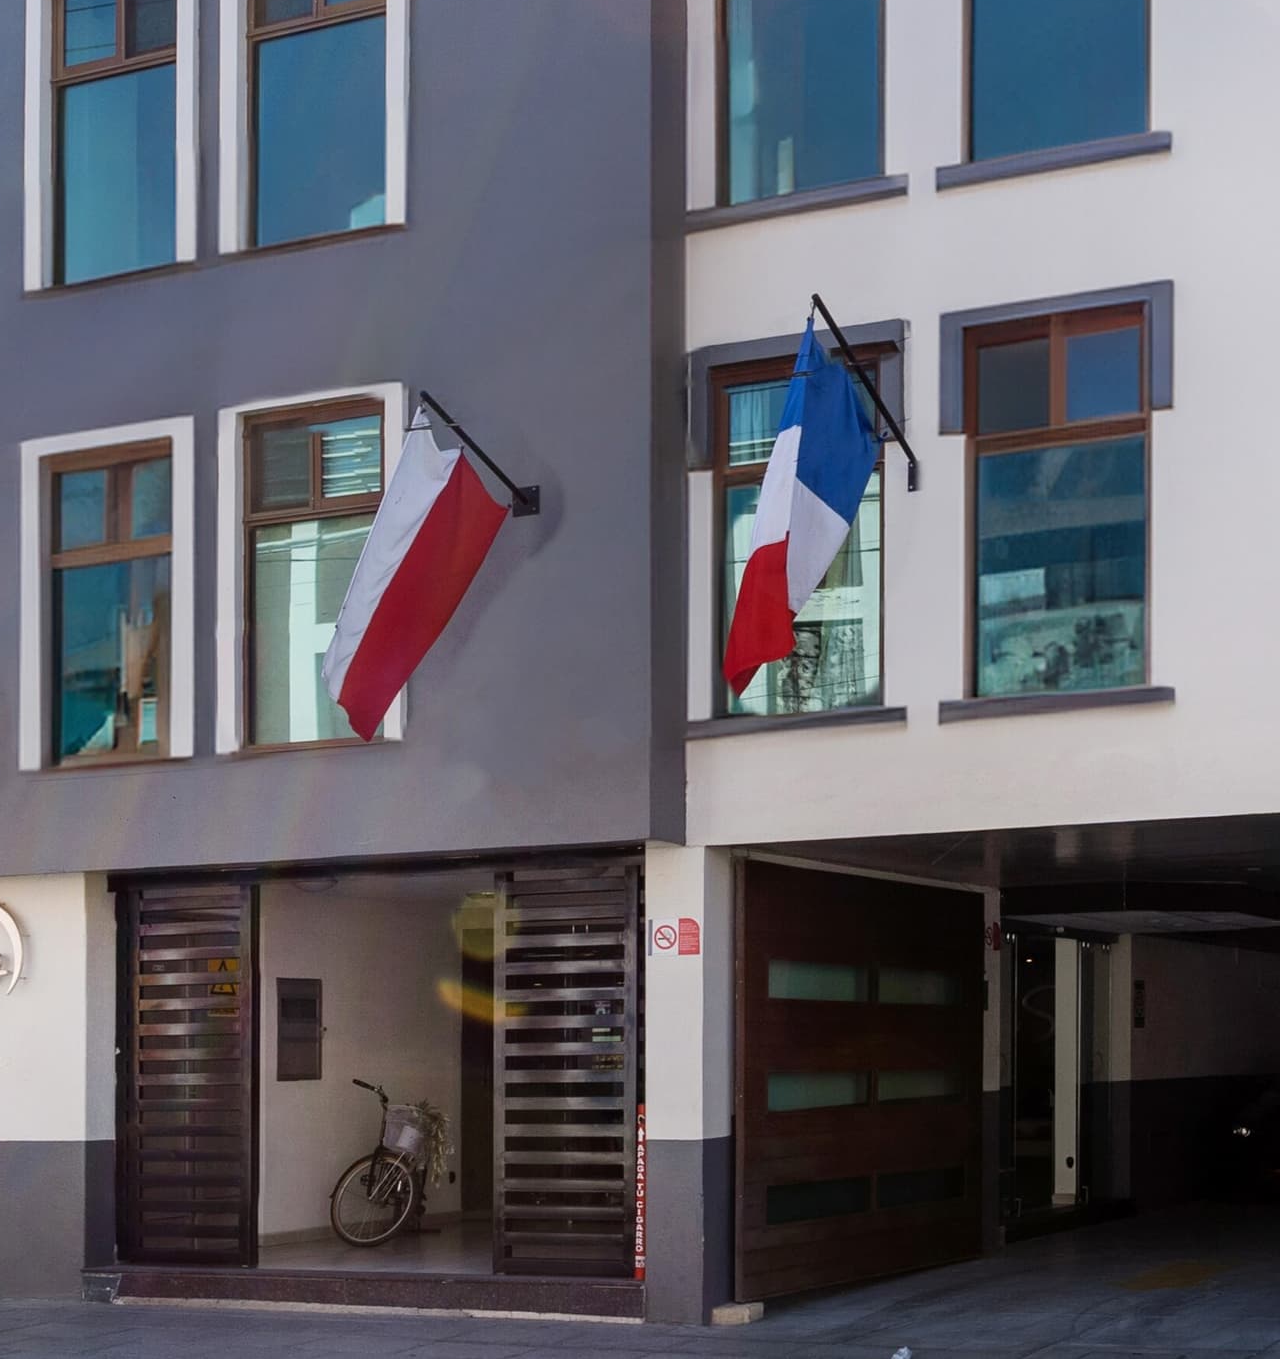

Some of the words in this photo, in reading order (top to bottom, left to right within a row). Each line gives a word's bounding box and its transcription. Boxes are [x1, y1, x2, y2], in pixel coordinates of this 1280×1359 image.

[637, 1144, 645, 1179] APAGA
[636, 1183, 644, 1197] TU
[636, 1200, 644, 1252] CIGARRO
